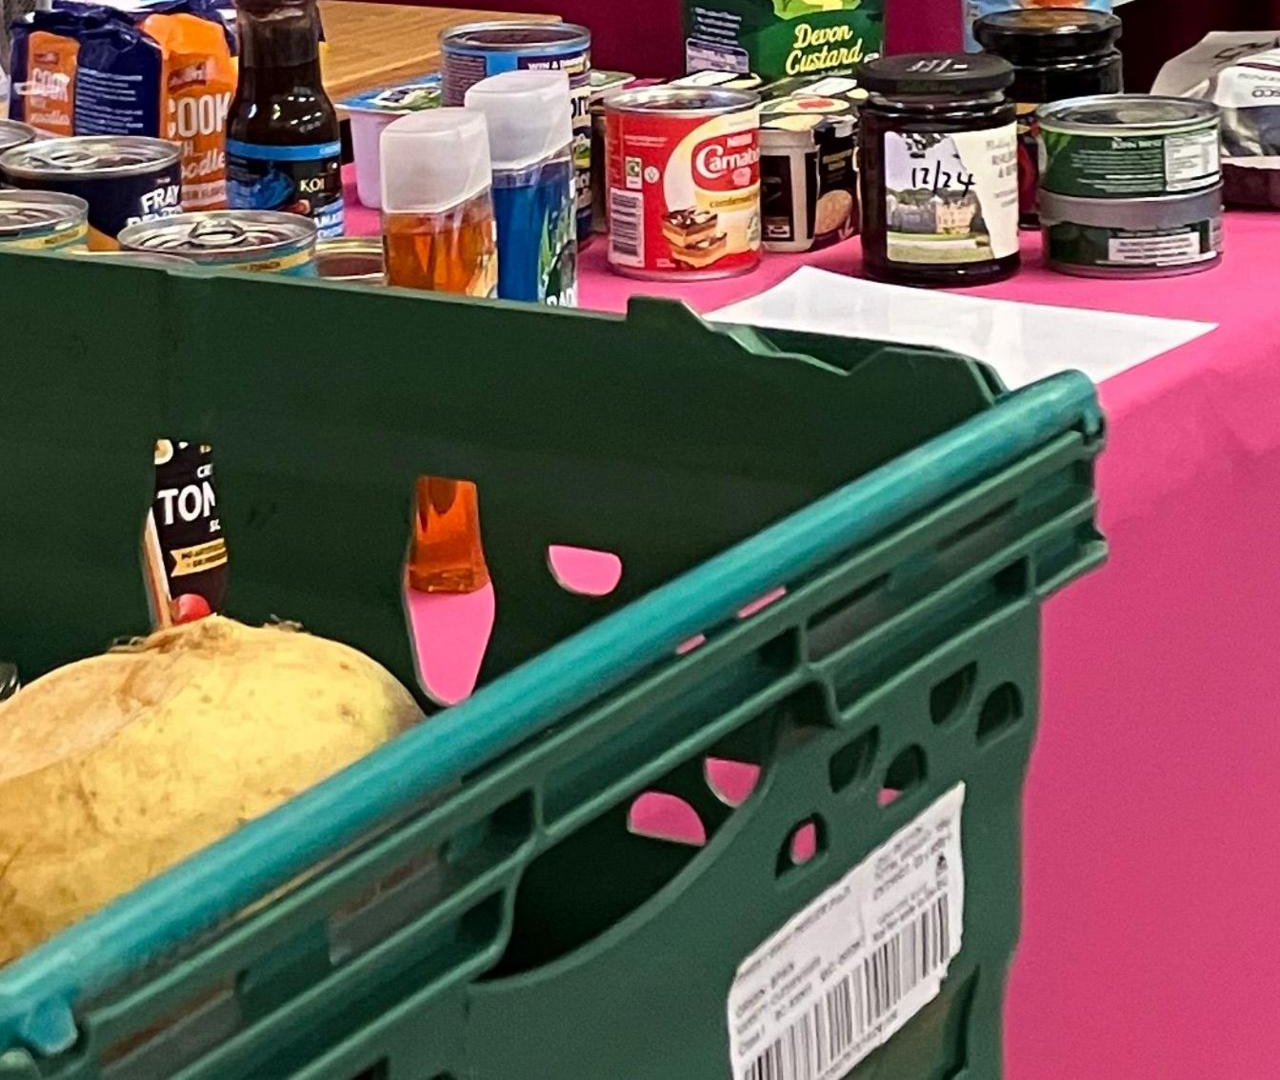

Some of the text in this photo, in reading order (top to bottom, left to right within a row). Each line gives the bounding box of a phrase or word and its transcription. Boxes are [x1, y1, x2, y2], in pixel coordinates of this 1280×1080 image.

[792, 22, 853, 49] Devon
[785, 37, 863, 76] Custard
[911, 160, 977, 198] 12/24
[140, 184, 181, 214] FRAY
